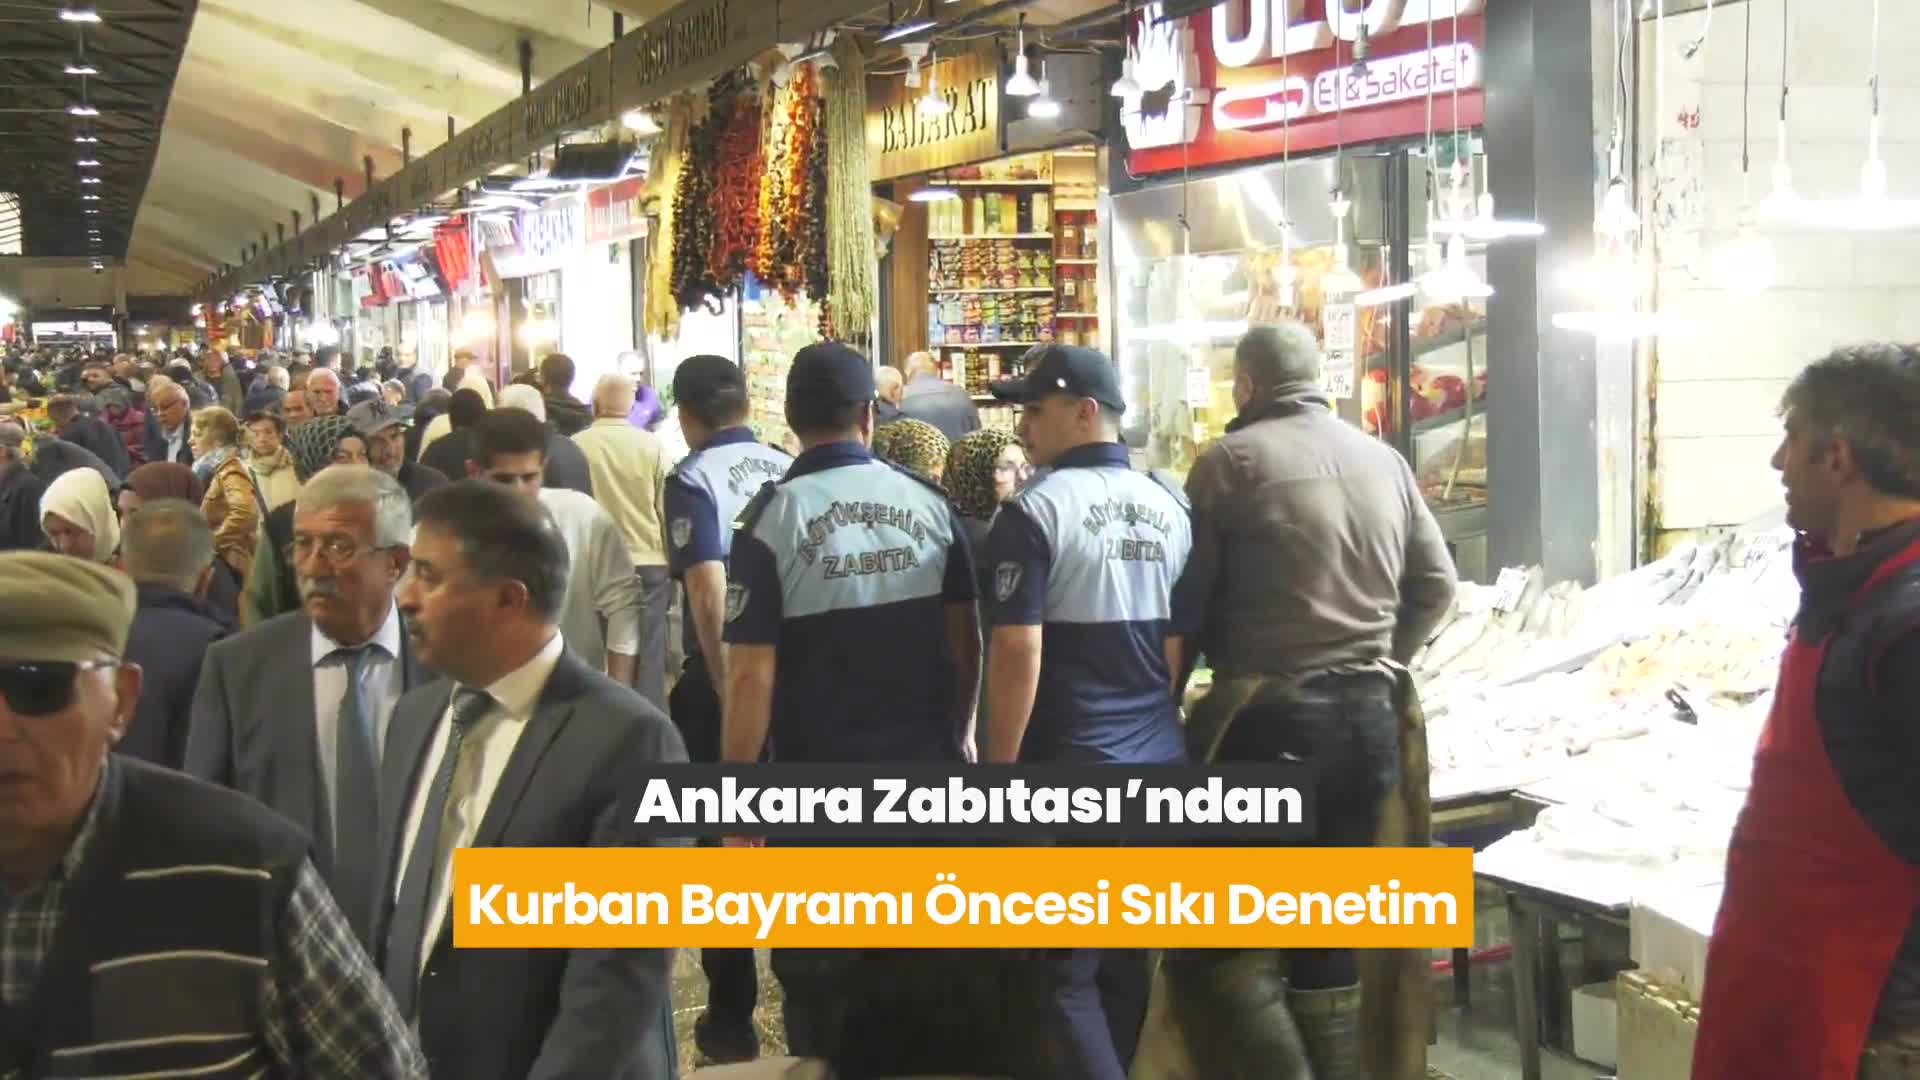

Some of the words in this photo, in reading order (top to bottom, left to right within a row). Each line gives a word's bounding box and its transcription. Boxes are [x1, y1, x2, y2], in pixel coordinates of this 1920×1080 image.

[1344, 70, 1361, 102] &
[1364, 48, 1470, 100] Sakatat
[822, 545, 921, 580] ZABITA
